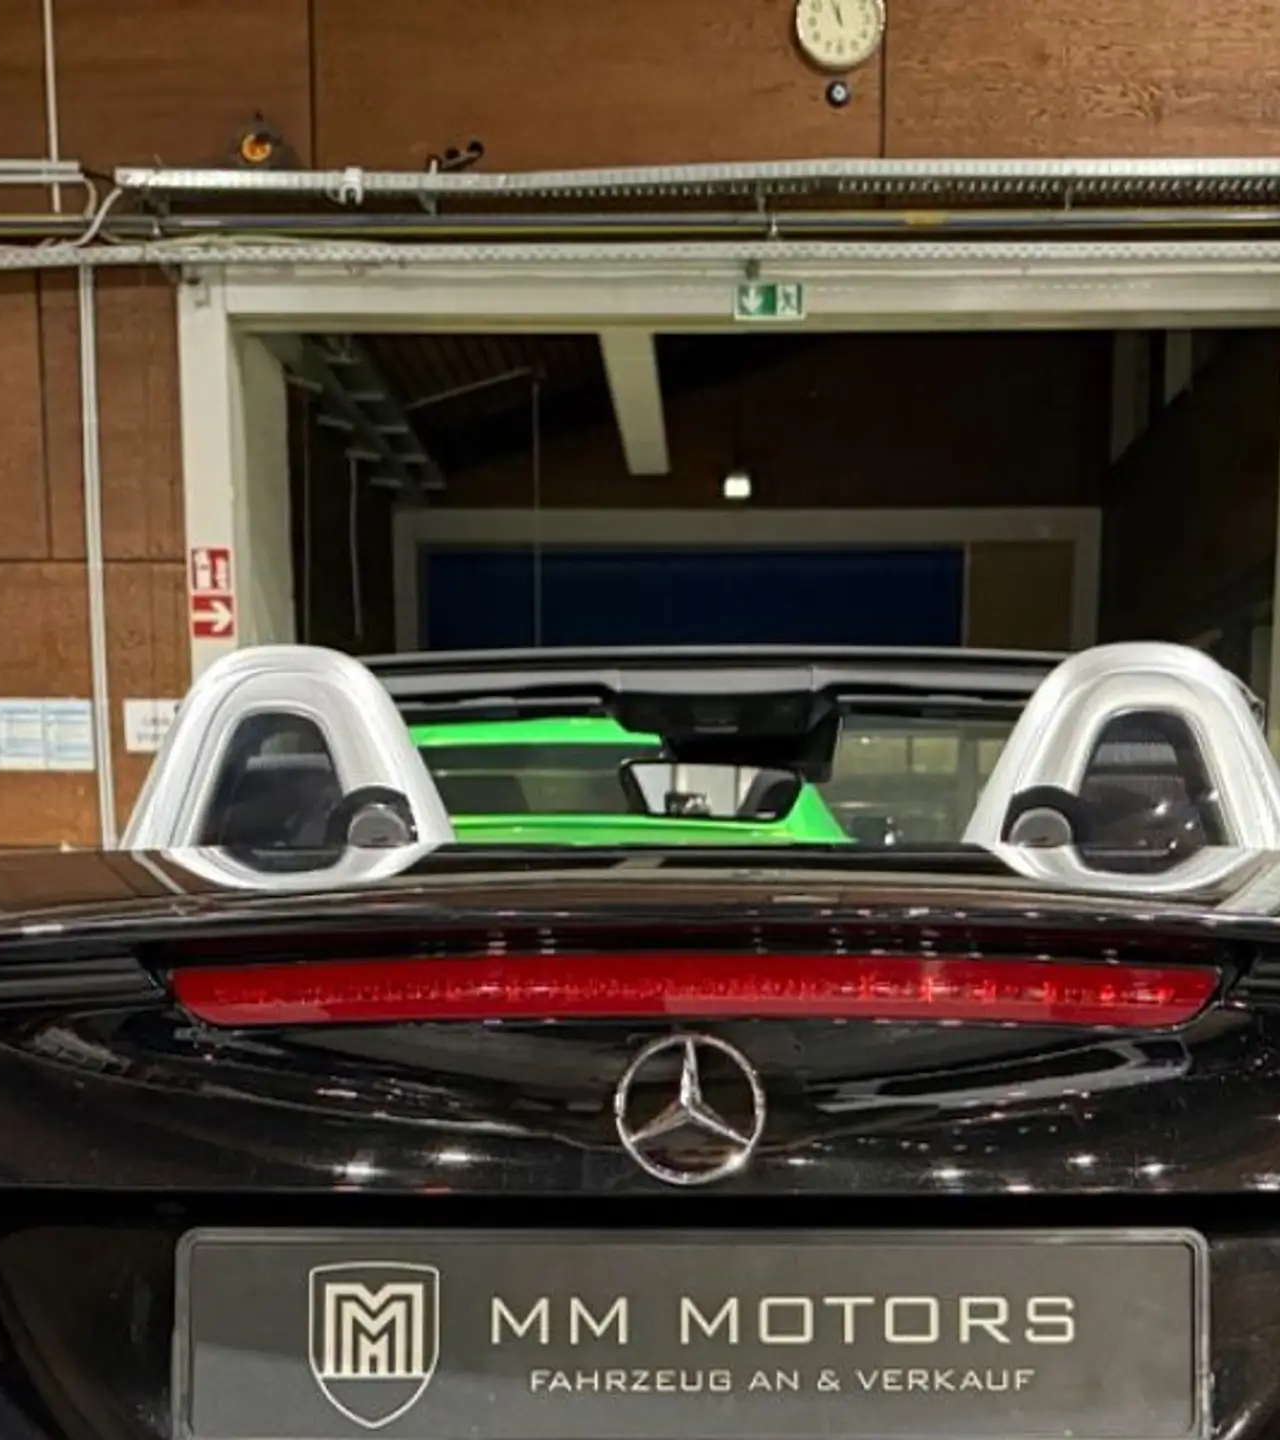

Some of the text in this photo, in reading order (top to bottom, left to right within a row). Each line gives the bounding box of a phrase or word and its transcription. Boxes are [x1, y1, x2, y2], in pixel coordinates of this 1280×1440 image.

[490, 1295, 1077, 1346] MM MOTORS
[529, 1368, 1036, 1394] FAHRZEUG AN & VERKAUF
